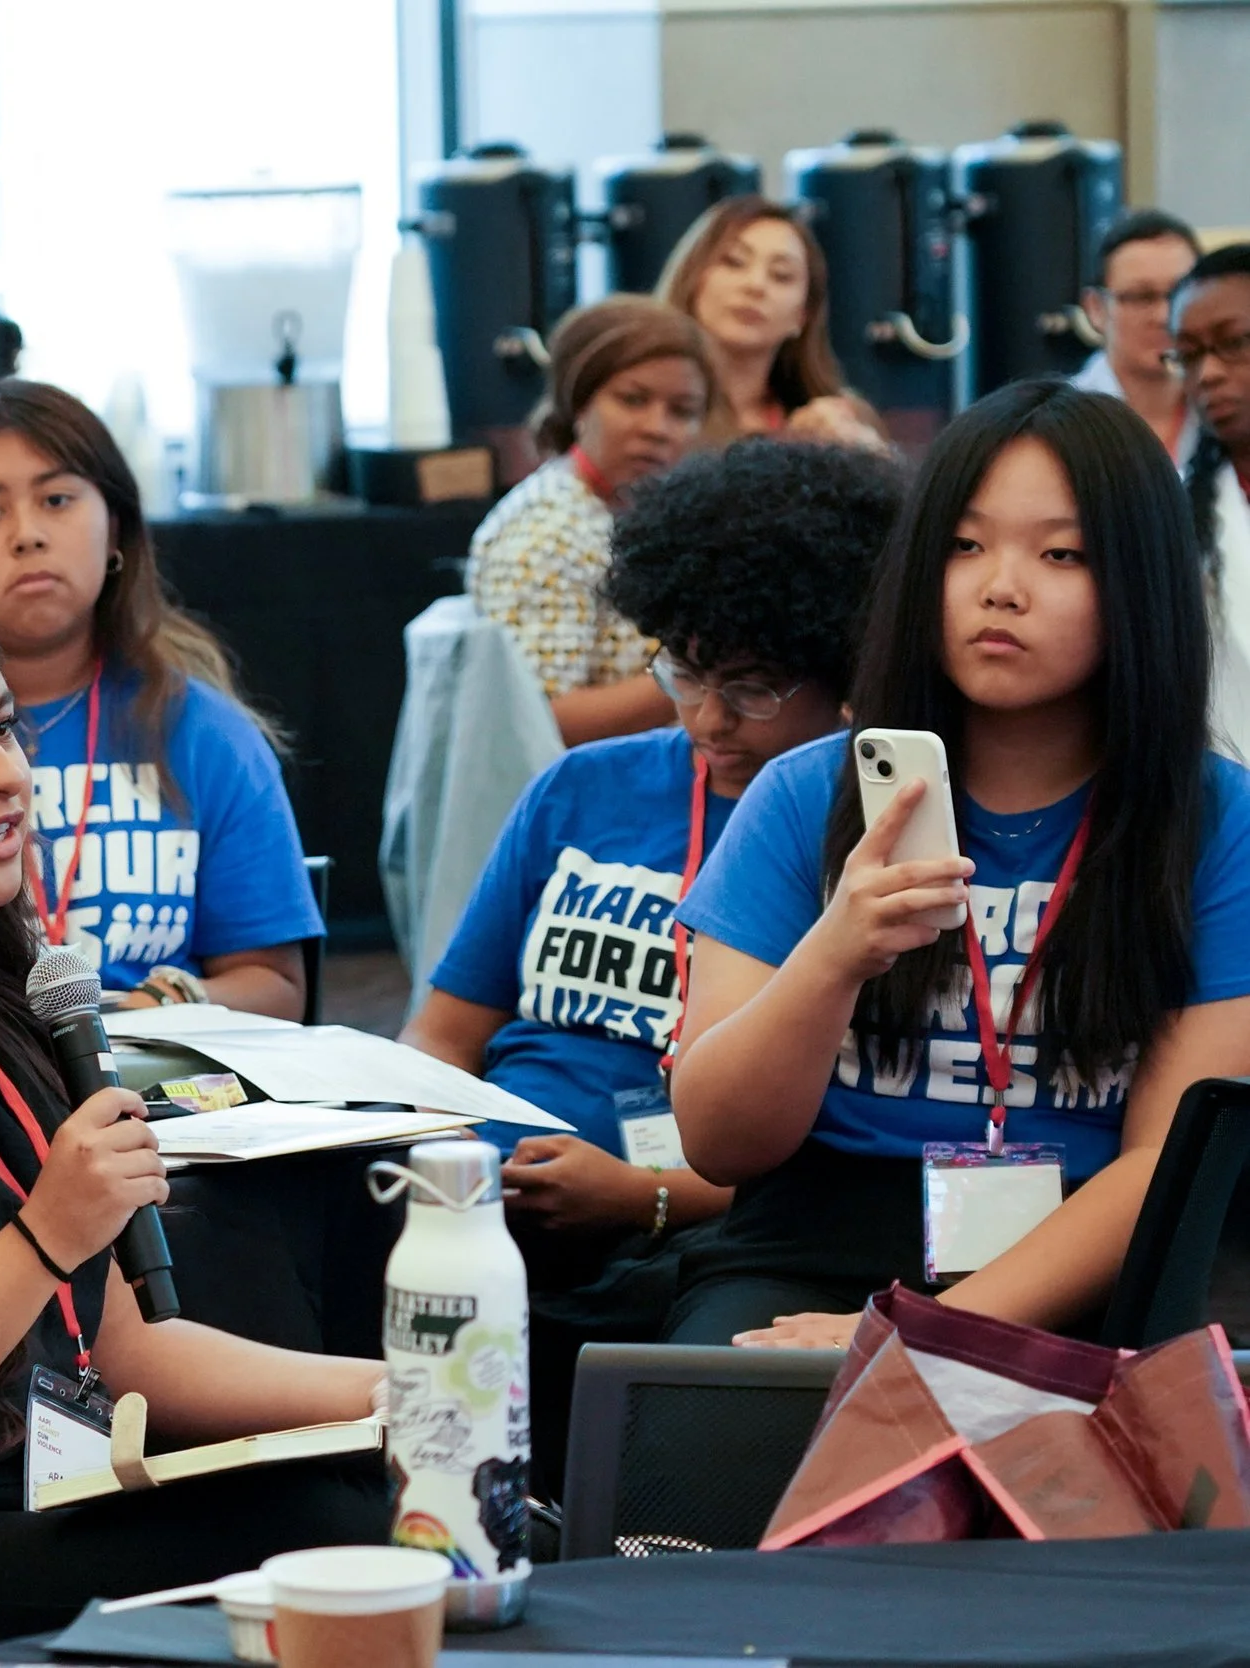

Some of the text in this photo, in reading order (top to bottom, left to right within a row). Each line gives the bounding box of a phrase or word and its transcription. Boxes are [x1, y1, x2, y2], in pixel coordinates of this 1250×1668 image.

[30, 763, 161, 829] RCH
[53, 830, 200, 899] OUR
[536, 926, 636, 989] FOR
[36, 1438, 63, 1456] VIOLENCE
